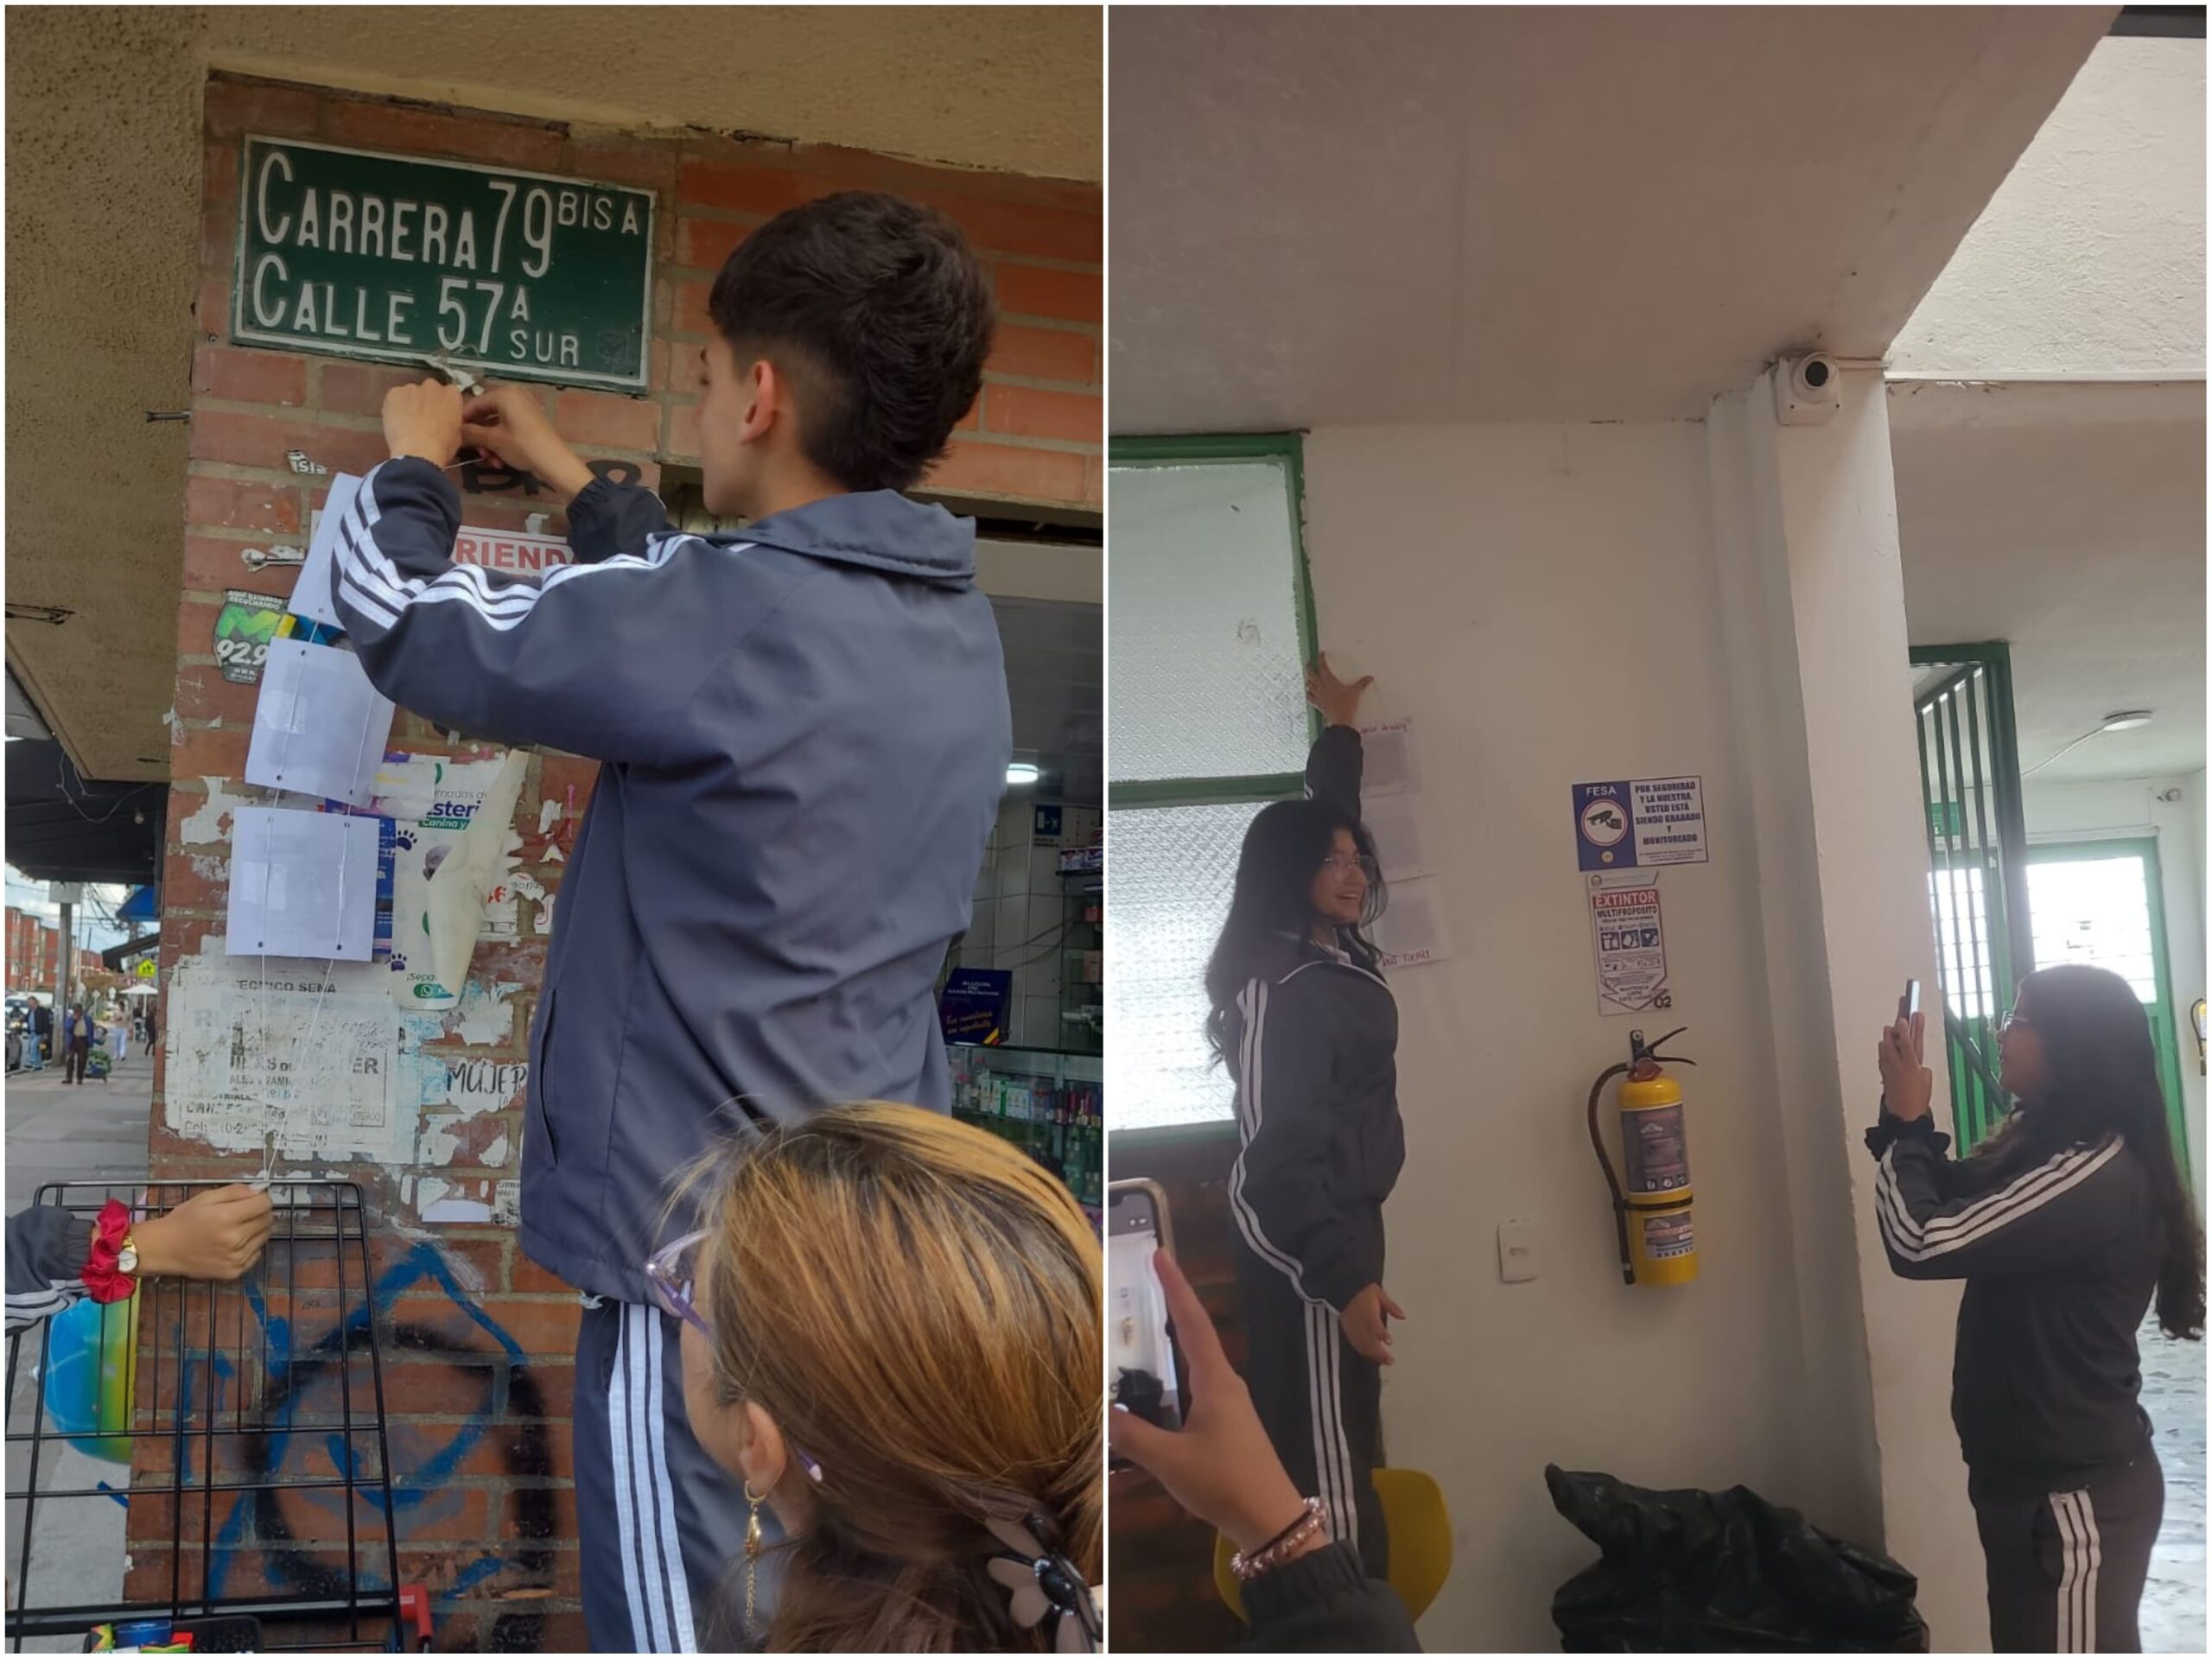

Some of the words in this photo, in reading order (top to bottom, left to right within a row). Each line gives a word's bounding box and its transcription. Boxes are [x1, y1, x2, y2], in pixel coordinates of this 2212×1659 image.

[259, 152, 477, 270] CARRERA
[489, 181, 553, 278] 79
[558, 192, 613, 231] BIS
[621, 202, 639, 235] A
[253, 254, 415, 345] CALLE
[438, 278, 504, 354] 57
[512, 285, 530, 321] A
[511, 329, 579, 365] SUR
[456, 537, 577, 570] RIEND
[1586, 785, 1617, 797] FESA
[1652, 781, 1695, 792] SEGURIDAD
[434, 790, 474, 799] rnadas
[1646, 794, 1656, 803] LA
[427, 800, 481, 817] steri
[1645, 805, 1669, 814] USTED
[422, 819, 458, 828] Canina
[459, 822, 467, 830] y
[1636, 816, 1663, 825] SIENDO
[1665, 813, 1700, 823] GRABADO
[1643, 834, 1698, 845] MONITOREADO
[1596, 891, 1656, 907] EXTINTOR
[1654, 995, 1671, 1008] 02
